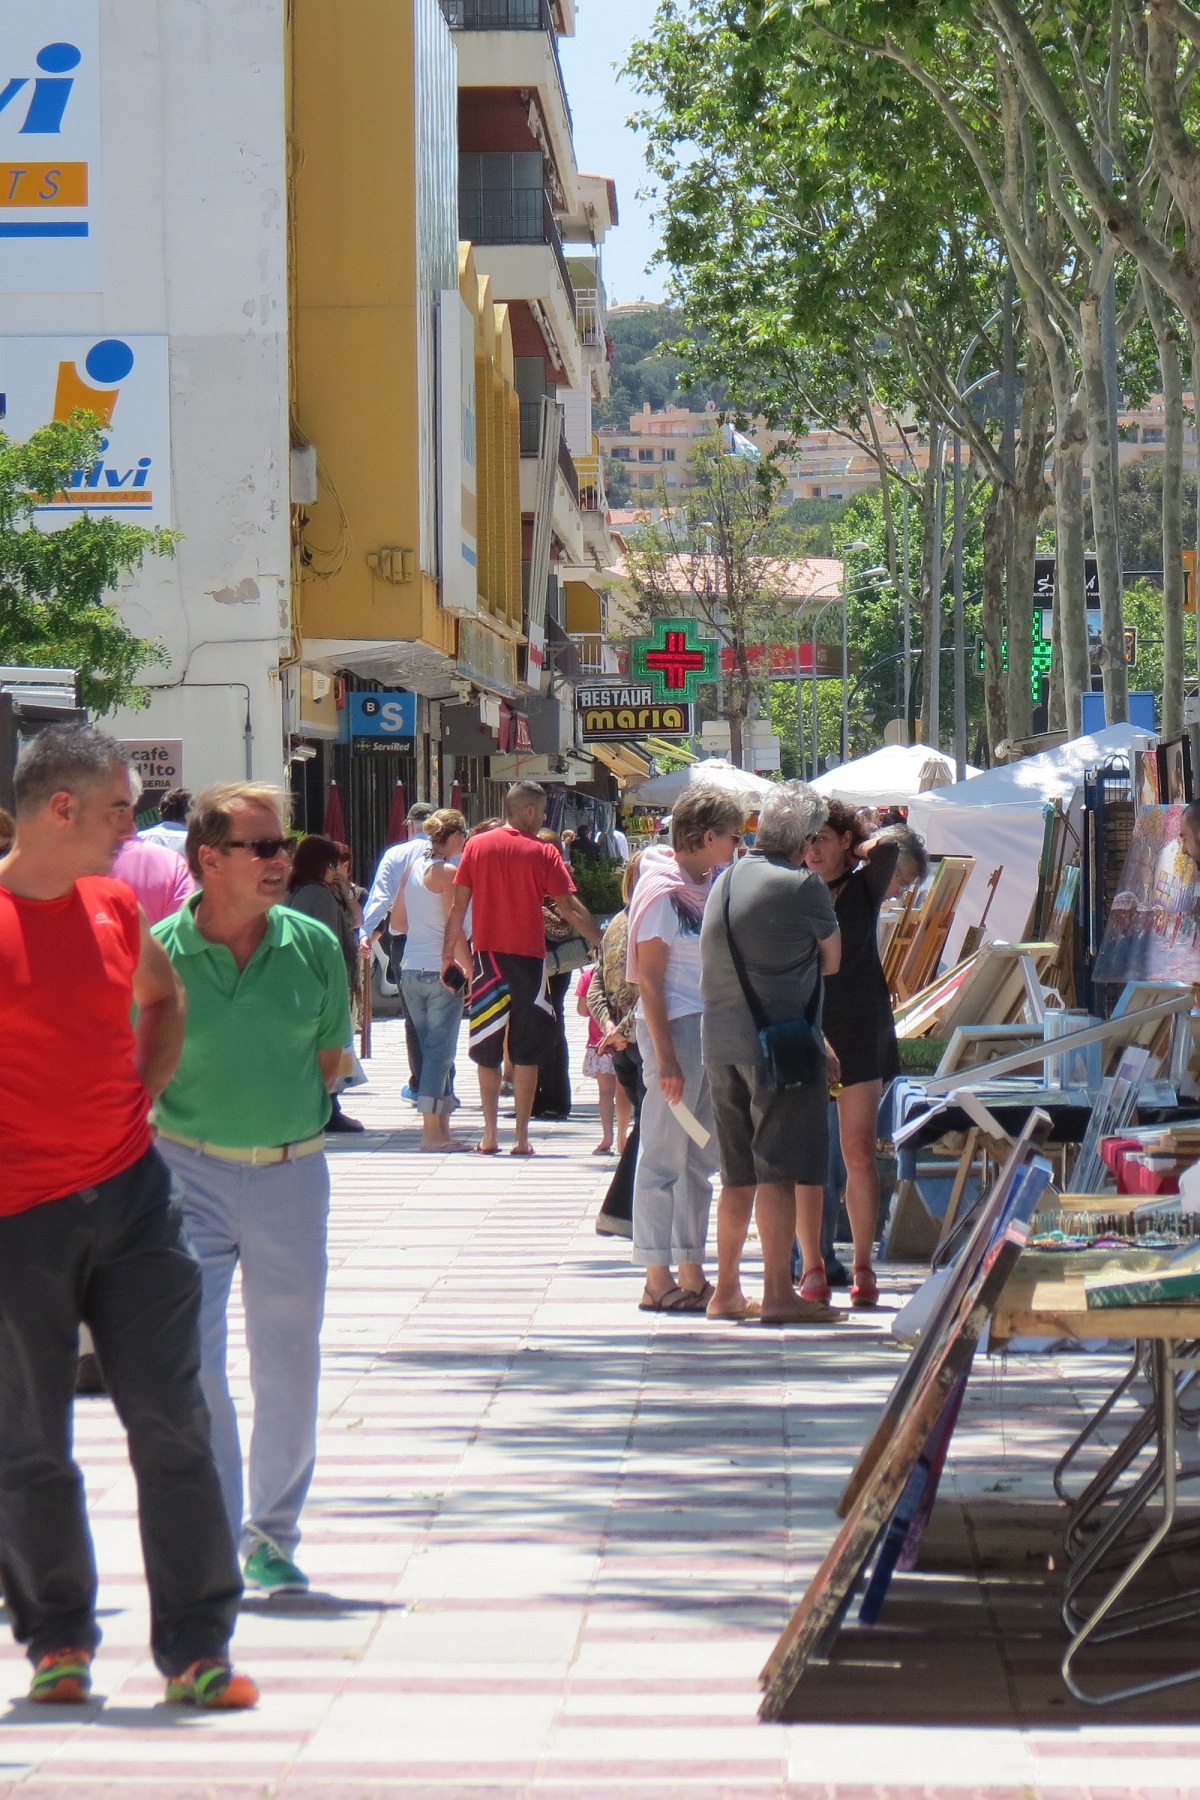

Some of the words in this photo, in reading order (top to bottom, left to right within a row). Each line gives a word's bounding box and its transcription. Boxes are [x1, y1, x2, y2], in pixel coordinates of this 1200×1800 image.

[366, 702, 375, 712] B
[380, 702, 403, 731] S
[586, 708, 681, 729] maria
[132, 747, 169, 760] cafè
[373, 742, 410, 751] ServiRed
